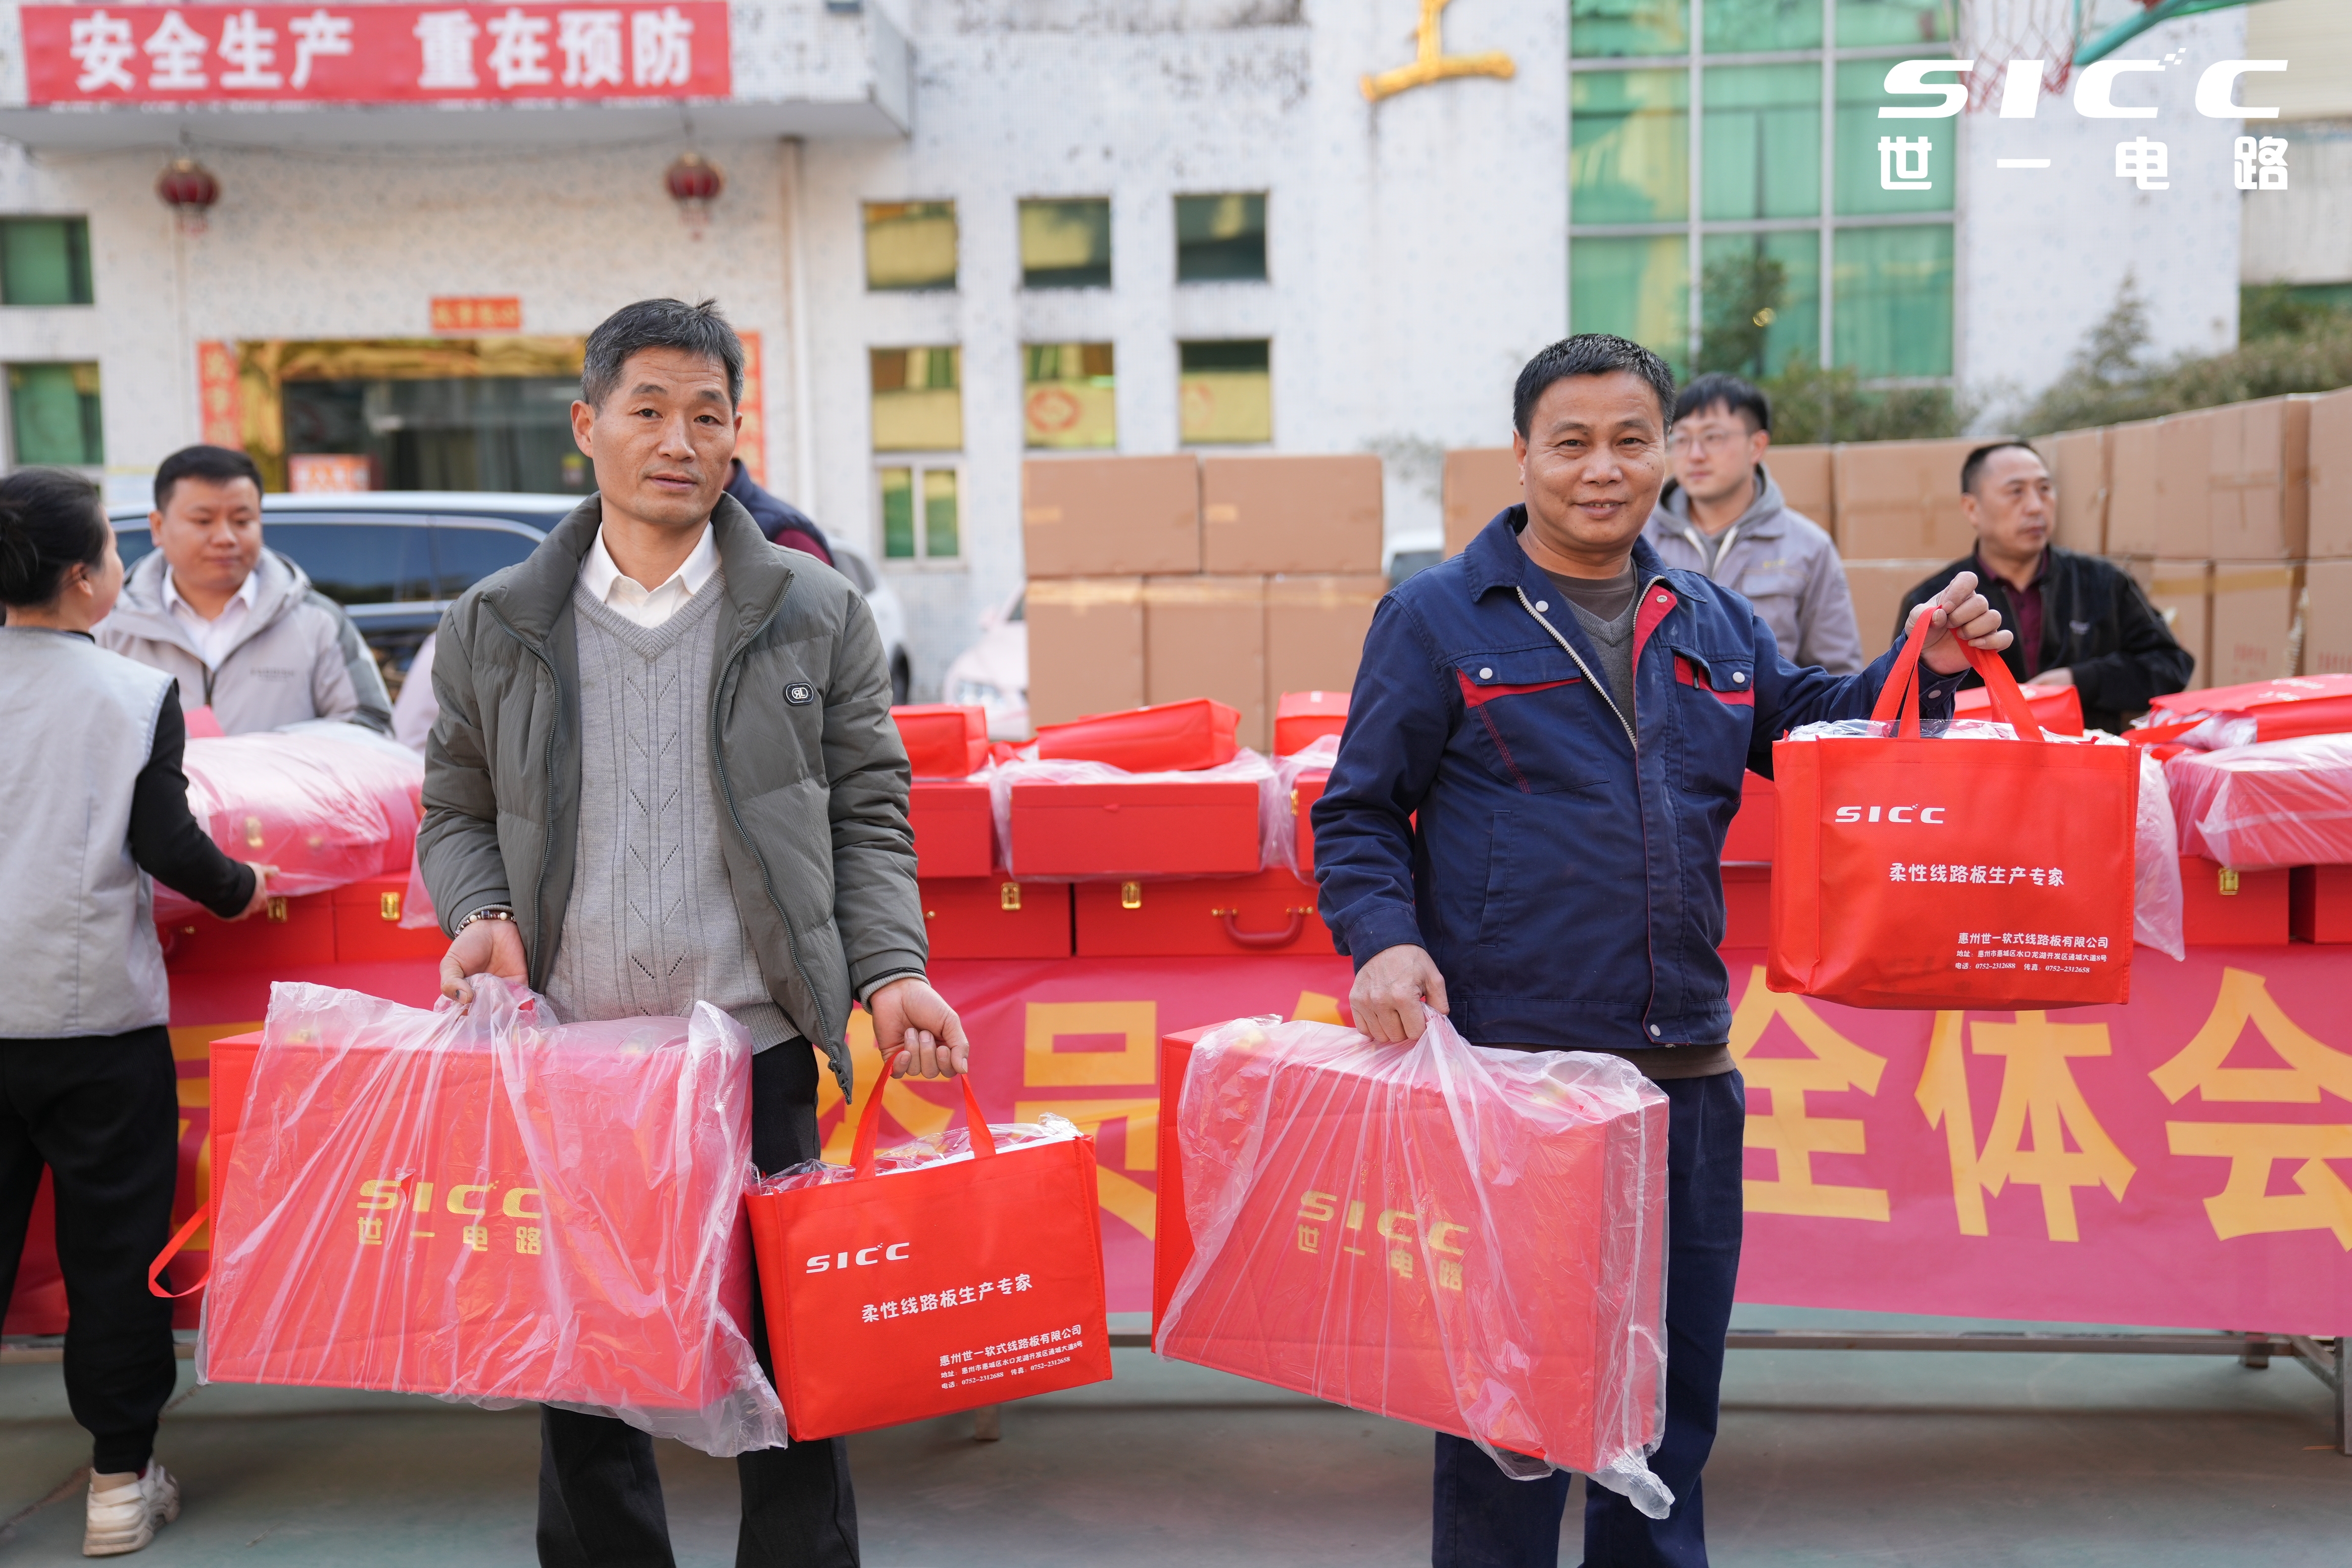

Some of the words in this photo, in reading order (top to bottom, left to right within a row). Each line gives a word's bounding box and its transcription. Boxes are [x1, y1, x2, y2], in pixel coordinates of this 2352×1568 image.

[69, 8, 353, 92] 安全生产
[413, 7, 694, 90] 重在预防
[1835, 804, 1946, 824] SICC
[1889, 862, 2065, 887] 柔性线路板生产专家
[1958, 932, 2108, 949] 惠州世一软式线路板有限公司
[356, 1179, 543, 1219] SICC
[357, 1217, 541, 1255] 世一电路
[1297, 1190, 1470, 1256] SICC
[806, 1242, 910, 1274] SICC
[1297, 1224, 1464, 1291] 世一电路
[861, 1273, 1033, 1323] 柔性线路板生产专家
[939, 1324, 1082, 1367] 惠州世一软式线路板有限公司
